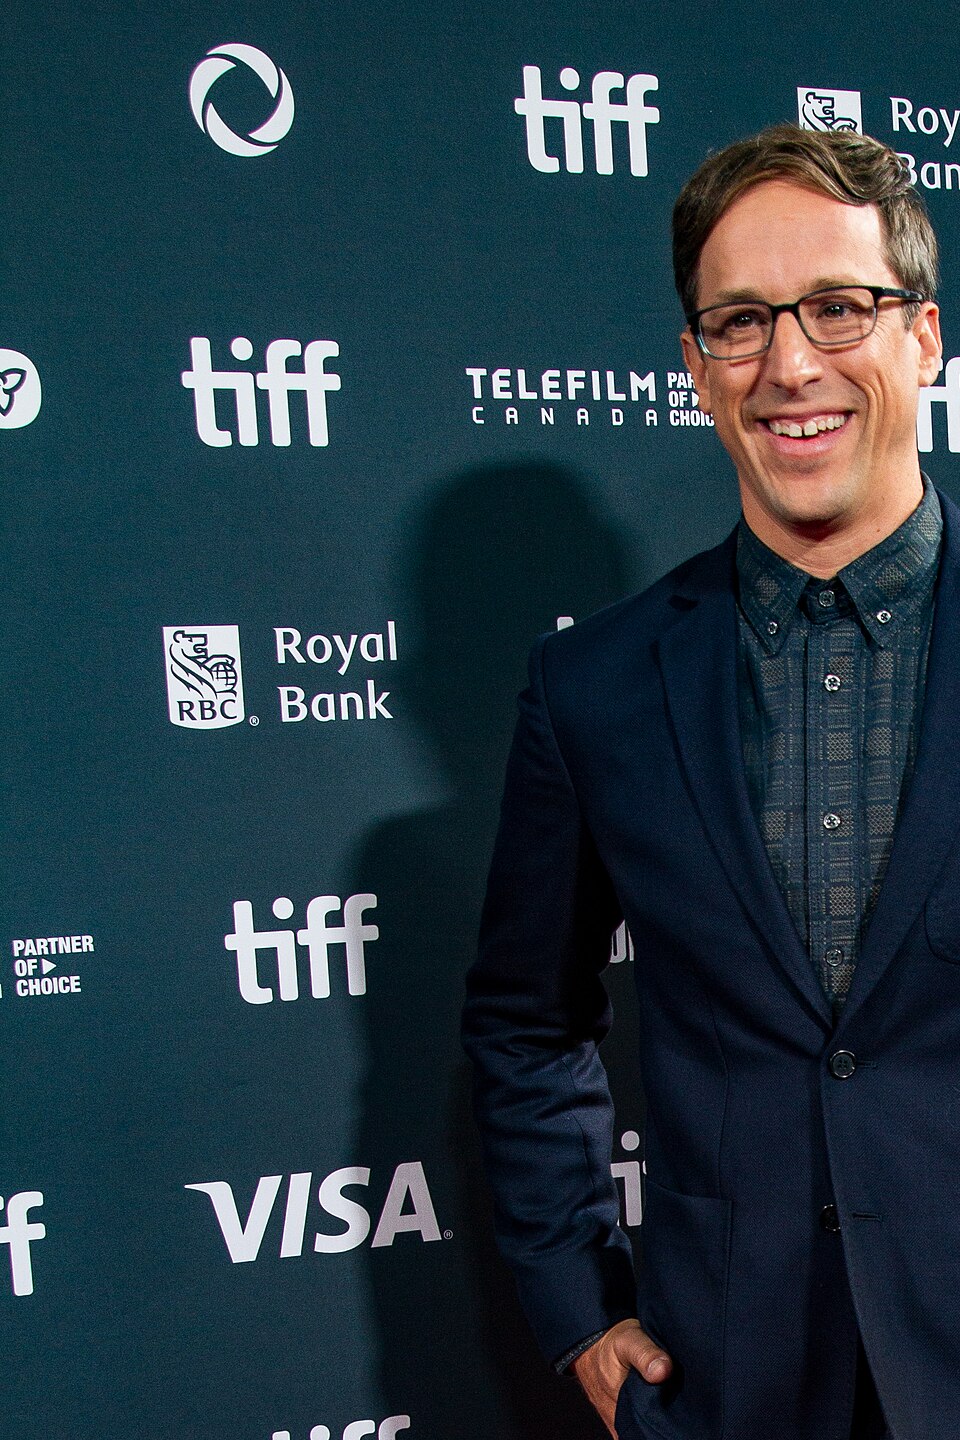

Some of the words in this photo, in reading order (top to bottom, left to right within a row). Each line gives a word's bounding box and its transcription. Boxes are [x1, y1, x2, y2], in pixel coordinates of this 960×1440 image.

[513, 65, 661, 178] tiff
[181, 336, 342, 448] tiff
[465, 367, 657, 402] TELEFILM
[668, 390, 688, 408] OF
[472, 407, 658, 426] CANADA
[272, 620, 398, 676] Royal
[177, 698, 238, 721] RBC
[277, 679, 394, 723] Bank
[12, 935, 95, 957] PARTNER
[223, 893, 380, 1005] tiff
[15, 958, 38, 977] OF
[16, 975, 82, 997] CHOICE
[184, 1161, 443, 1264] VISA
